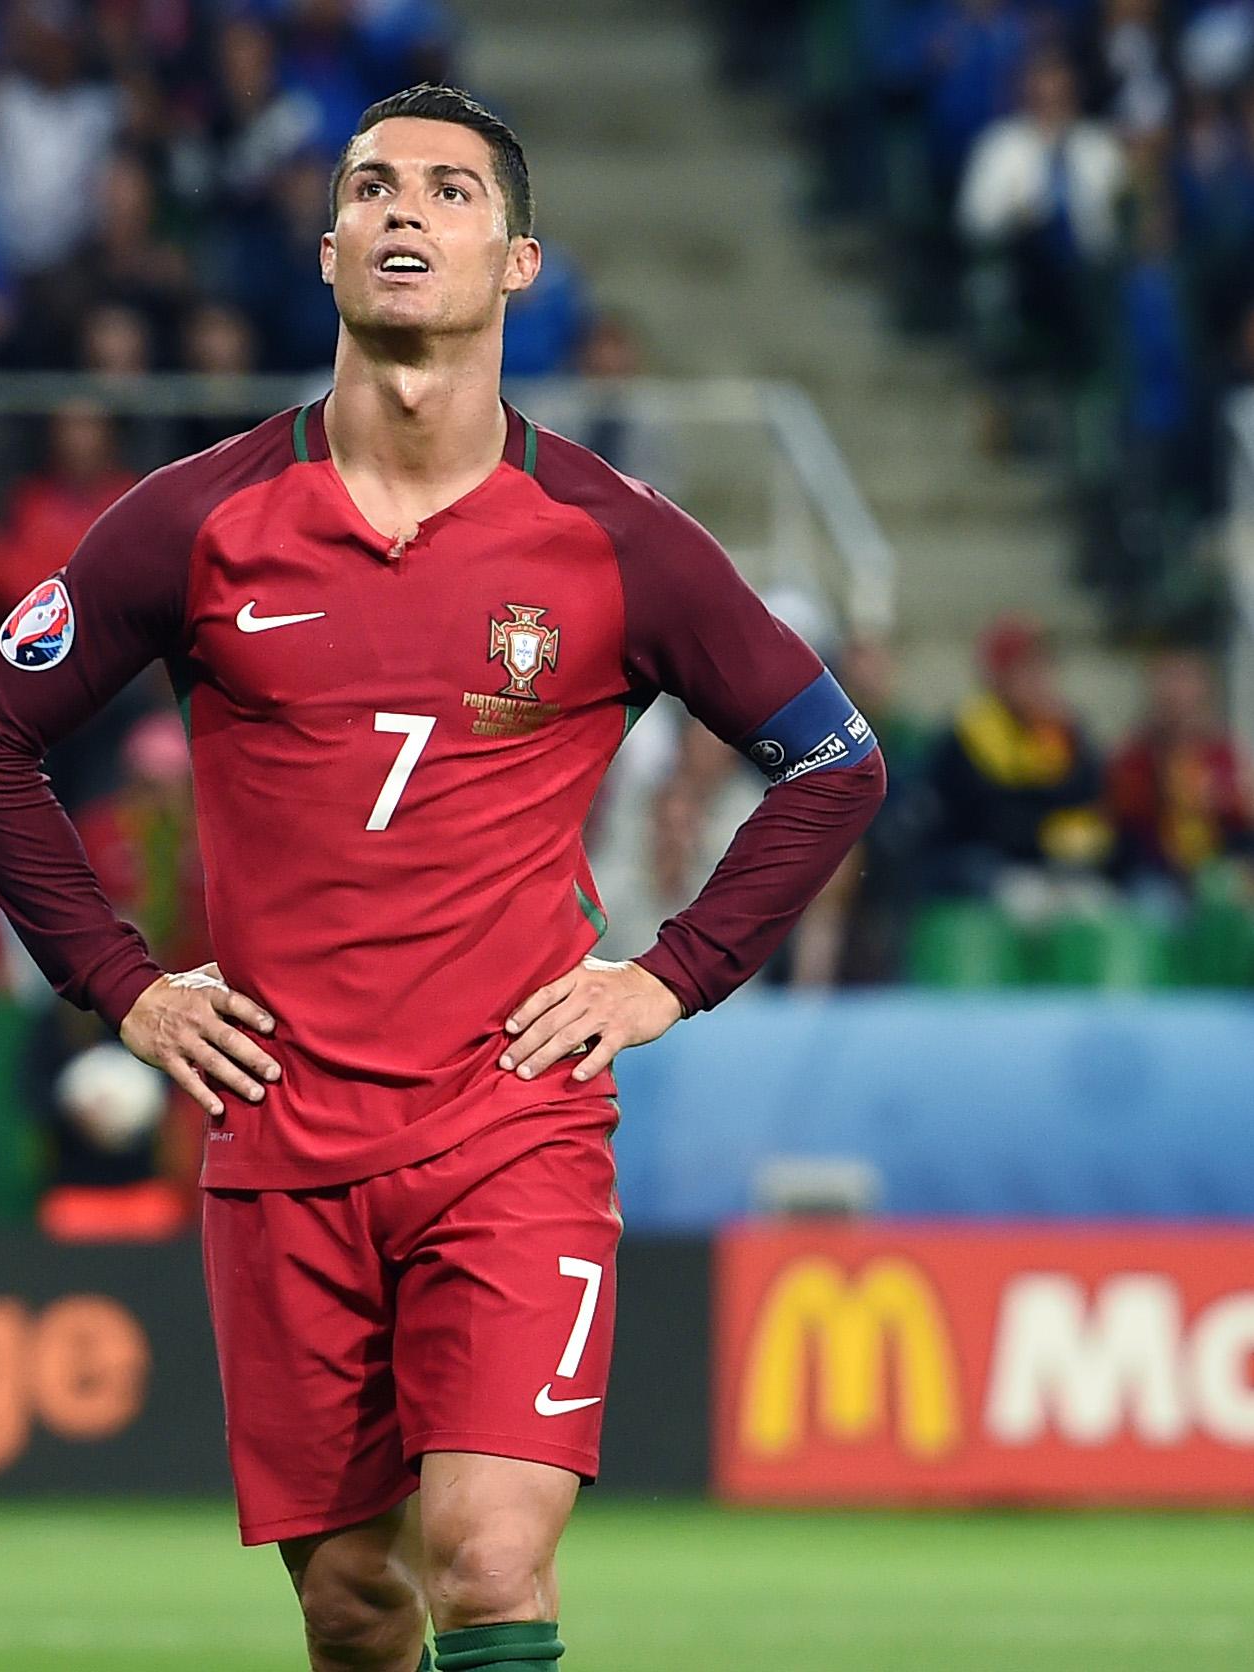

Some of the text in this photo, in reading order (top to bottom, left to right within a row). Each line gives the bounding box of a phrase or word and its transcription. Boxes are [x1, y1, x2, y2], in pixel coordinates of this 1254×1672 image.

[365, 712, 437, 831] 7
[785, 738, 846, 778] RACISM
[556, 1256, 603, 1379] 7
